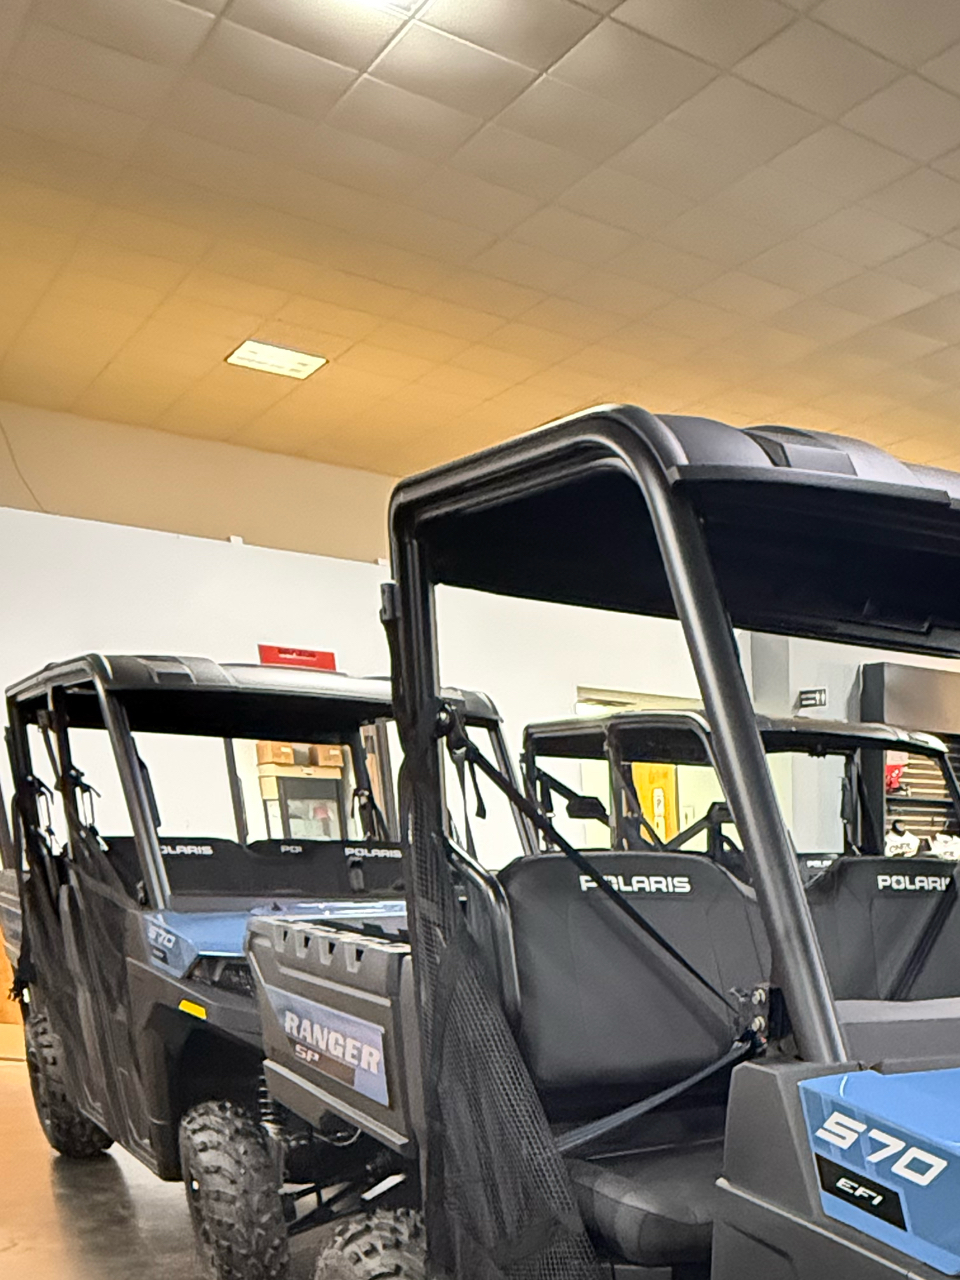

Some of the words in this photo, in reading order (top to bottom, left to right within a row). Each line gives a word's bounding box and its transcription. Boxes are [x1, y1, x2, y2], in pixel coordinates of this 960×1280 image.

[160, 845, 214, 855] OLARIS
[345, 847, 402, 858] POLARIS
[877, 875, 950, 891] POLARI
[285, 1010, 380, 1075] RANGER
[295, 1044, 320, 1062] SP
[815, 1111, 948, 1186] 570
[836, 1177, 883, 1205] EFI
